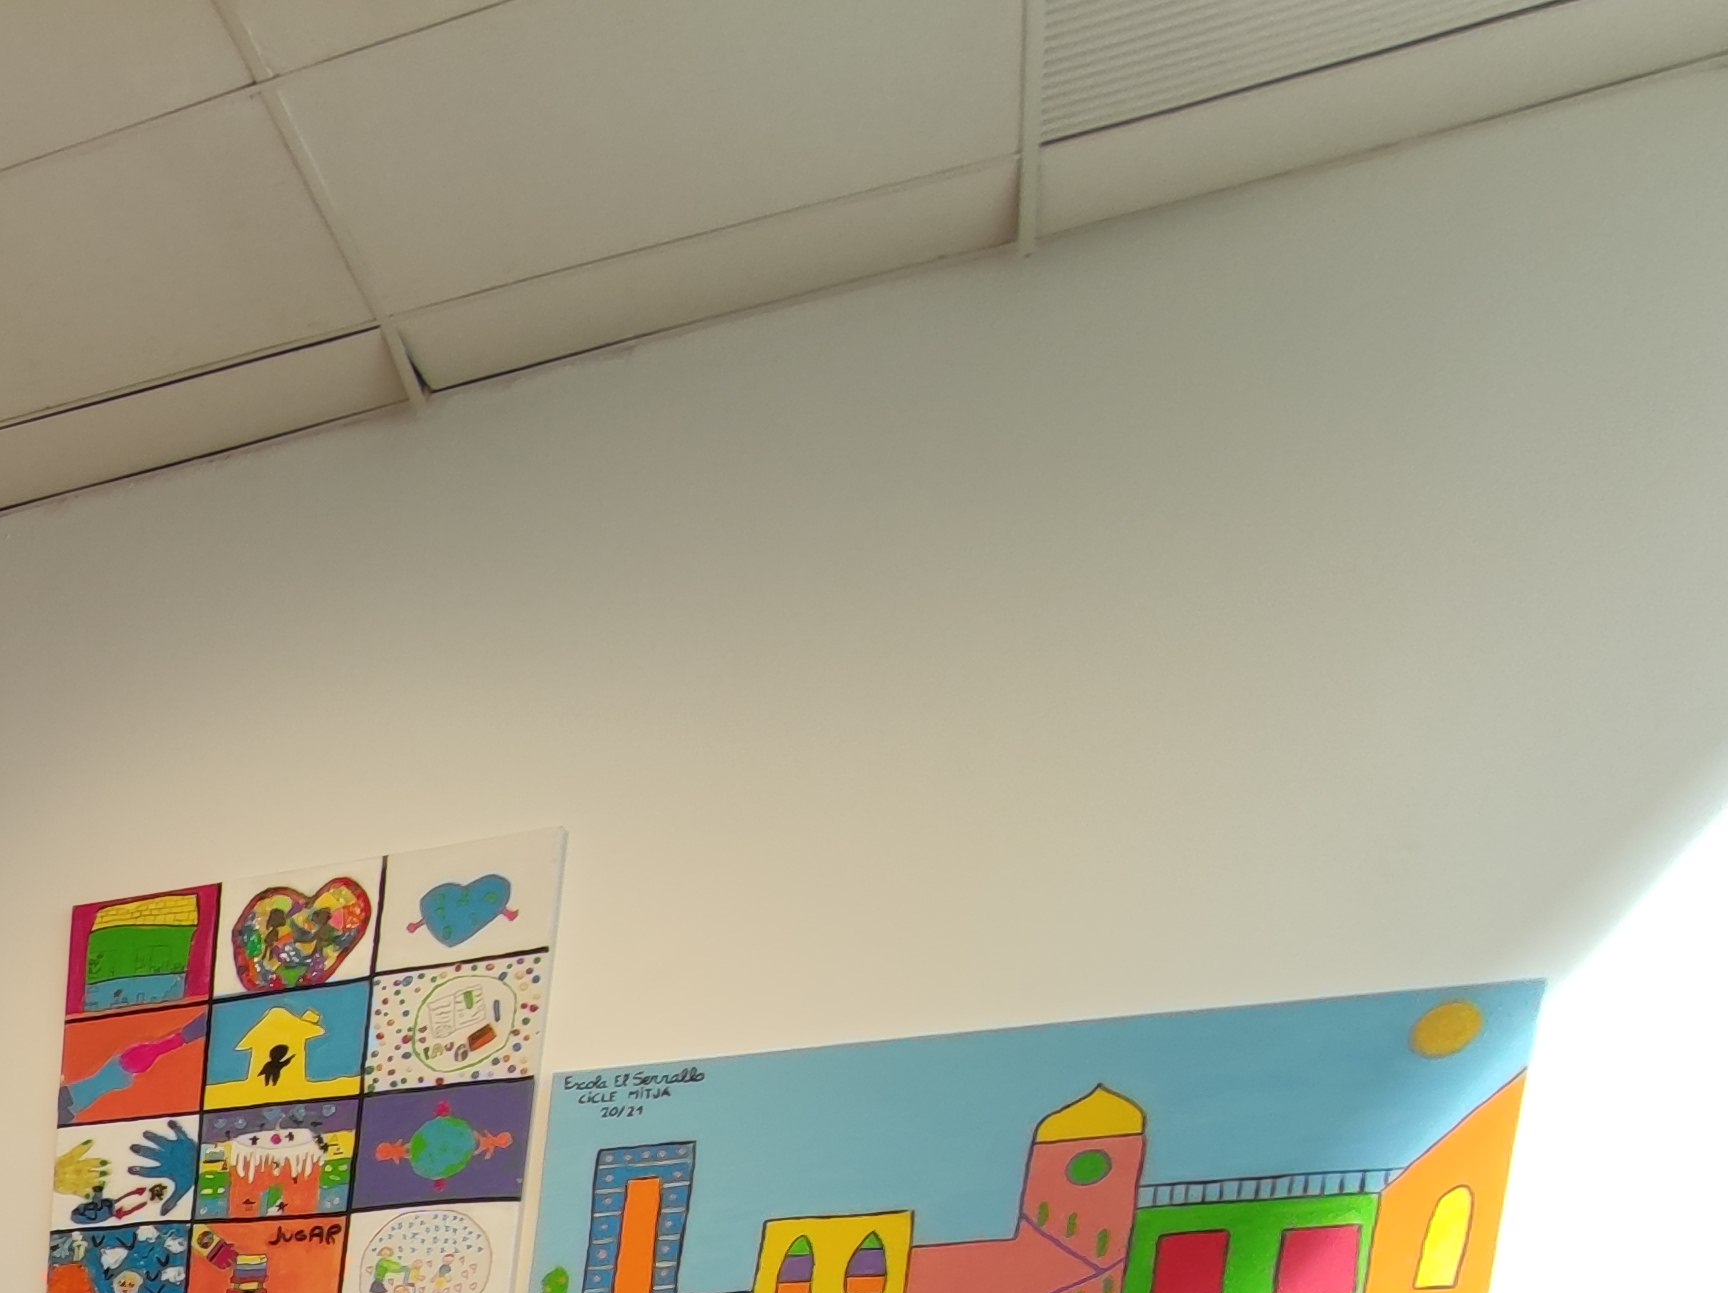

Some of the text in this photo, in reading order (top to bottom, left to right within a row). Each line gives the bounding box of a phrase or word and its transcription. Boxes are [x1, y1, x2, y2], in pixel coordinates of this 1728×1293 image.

[564, 1067, 705, 1090] Escola El Serrallo
[600, 1105, 643, 1118] 20/21
[268, 1223, 342, 1245] JUGAR
